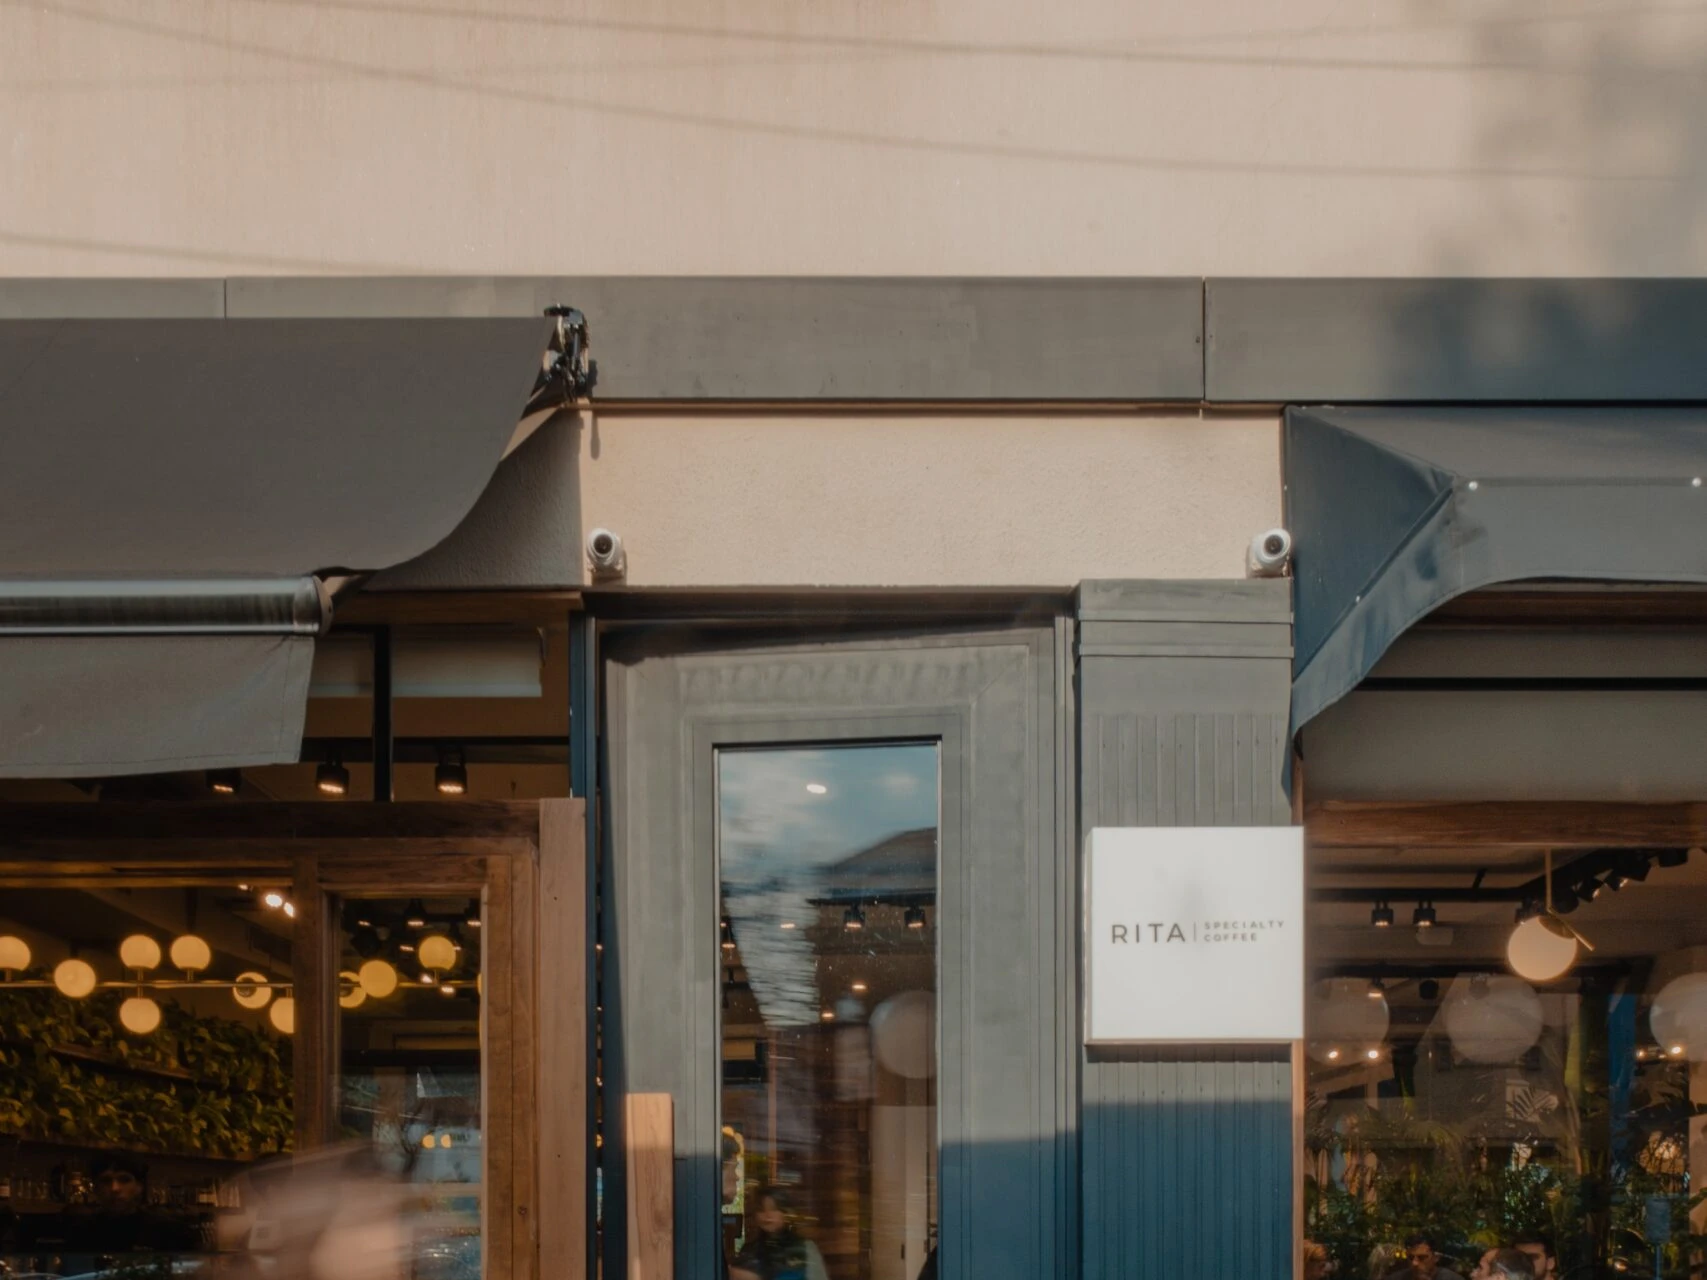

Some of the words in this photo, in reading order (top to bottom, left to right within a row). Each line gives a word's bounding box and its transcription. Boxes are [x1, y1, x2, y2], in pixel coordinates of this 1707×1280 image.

[1203, 920, 1285, 930] SPECIALTY
[1111, 922, 1187, 944] RITA
[1203, 932, 1258, 942] COFFEE
